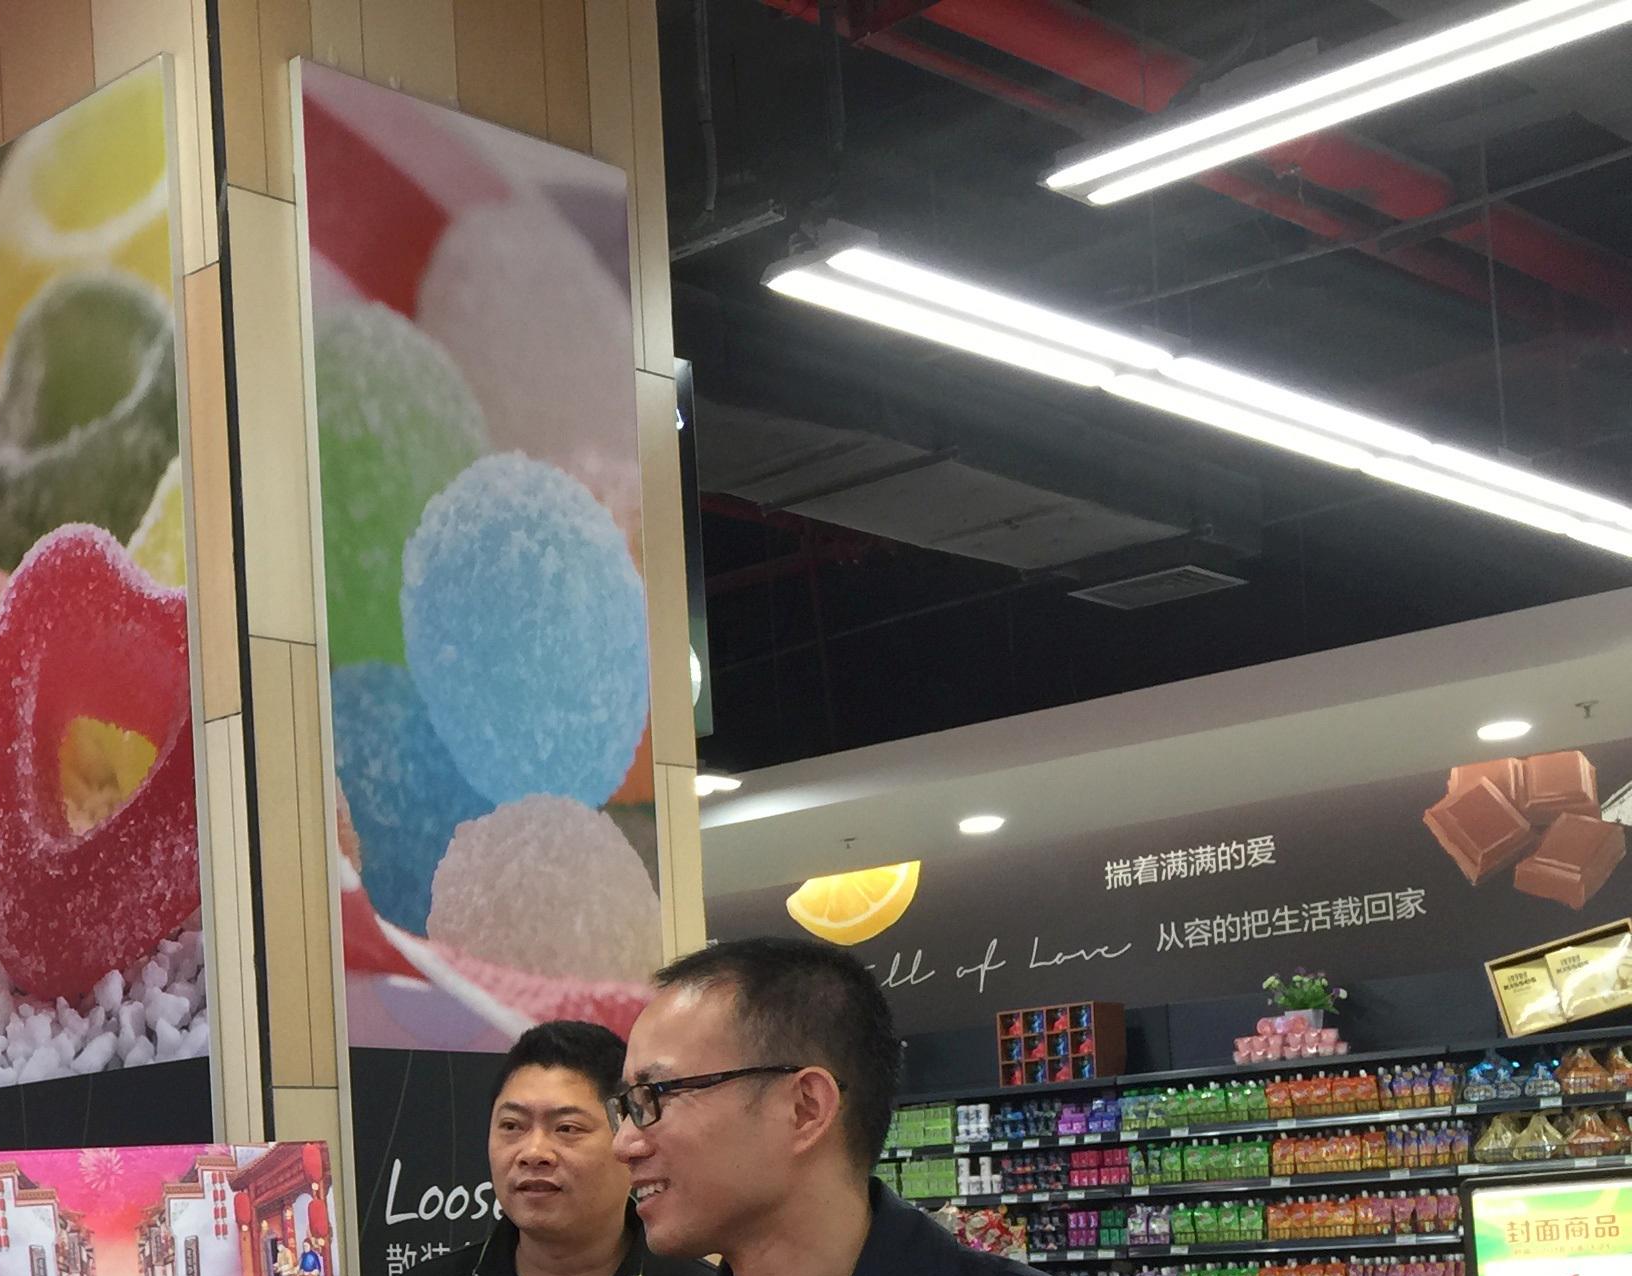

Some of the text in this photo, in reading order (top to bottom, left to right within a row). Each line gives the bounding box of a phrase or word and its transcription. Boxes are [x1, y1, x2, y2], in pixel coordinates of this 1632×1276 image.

[1104, 834, 1277, 890] 揣着满满的爱
[1156, 888, 1427, 952] 从容的把生活载回家
[957, 938, 1006, 993] of
[1029, 938, 1132, 988] Love
[1506, 1214, 1620, 1244] 封面商品
